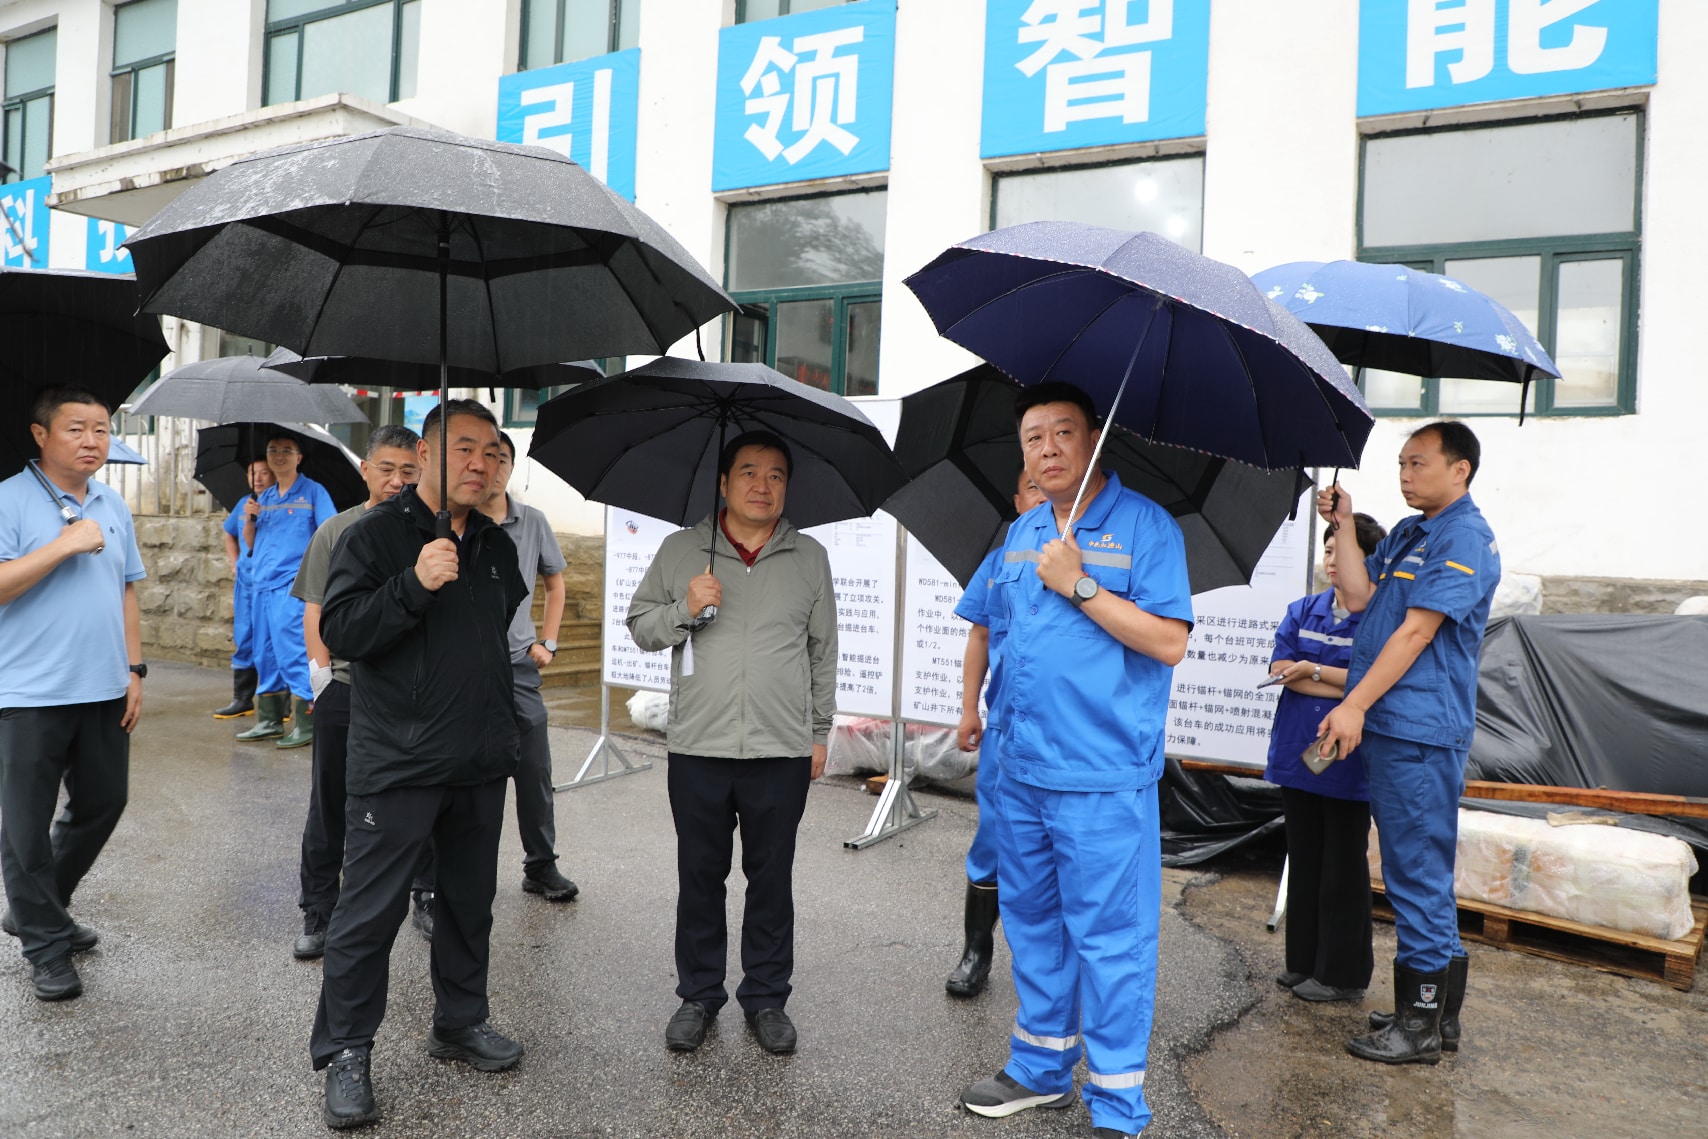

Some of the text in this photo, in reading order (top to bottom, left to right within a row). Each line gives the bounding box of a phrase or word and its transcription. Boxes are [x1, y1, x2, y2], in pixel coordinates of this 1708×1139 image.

[740, 25, 864, 165] 领
[1015, 0, 1173, 133] 智
[520, 68, 613, 186] 引
[1168, 699, 1276, 721] 面锚杆+锚网+喷射混凝
[1176, 682, 1281, 704] 进行锚杆+锚网的全顶
